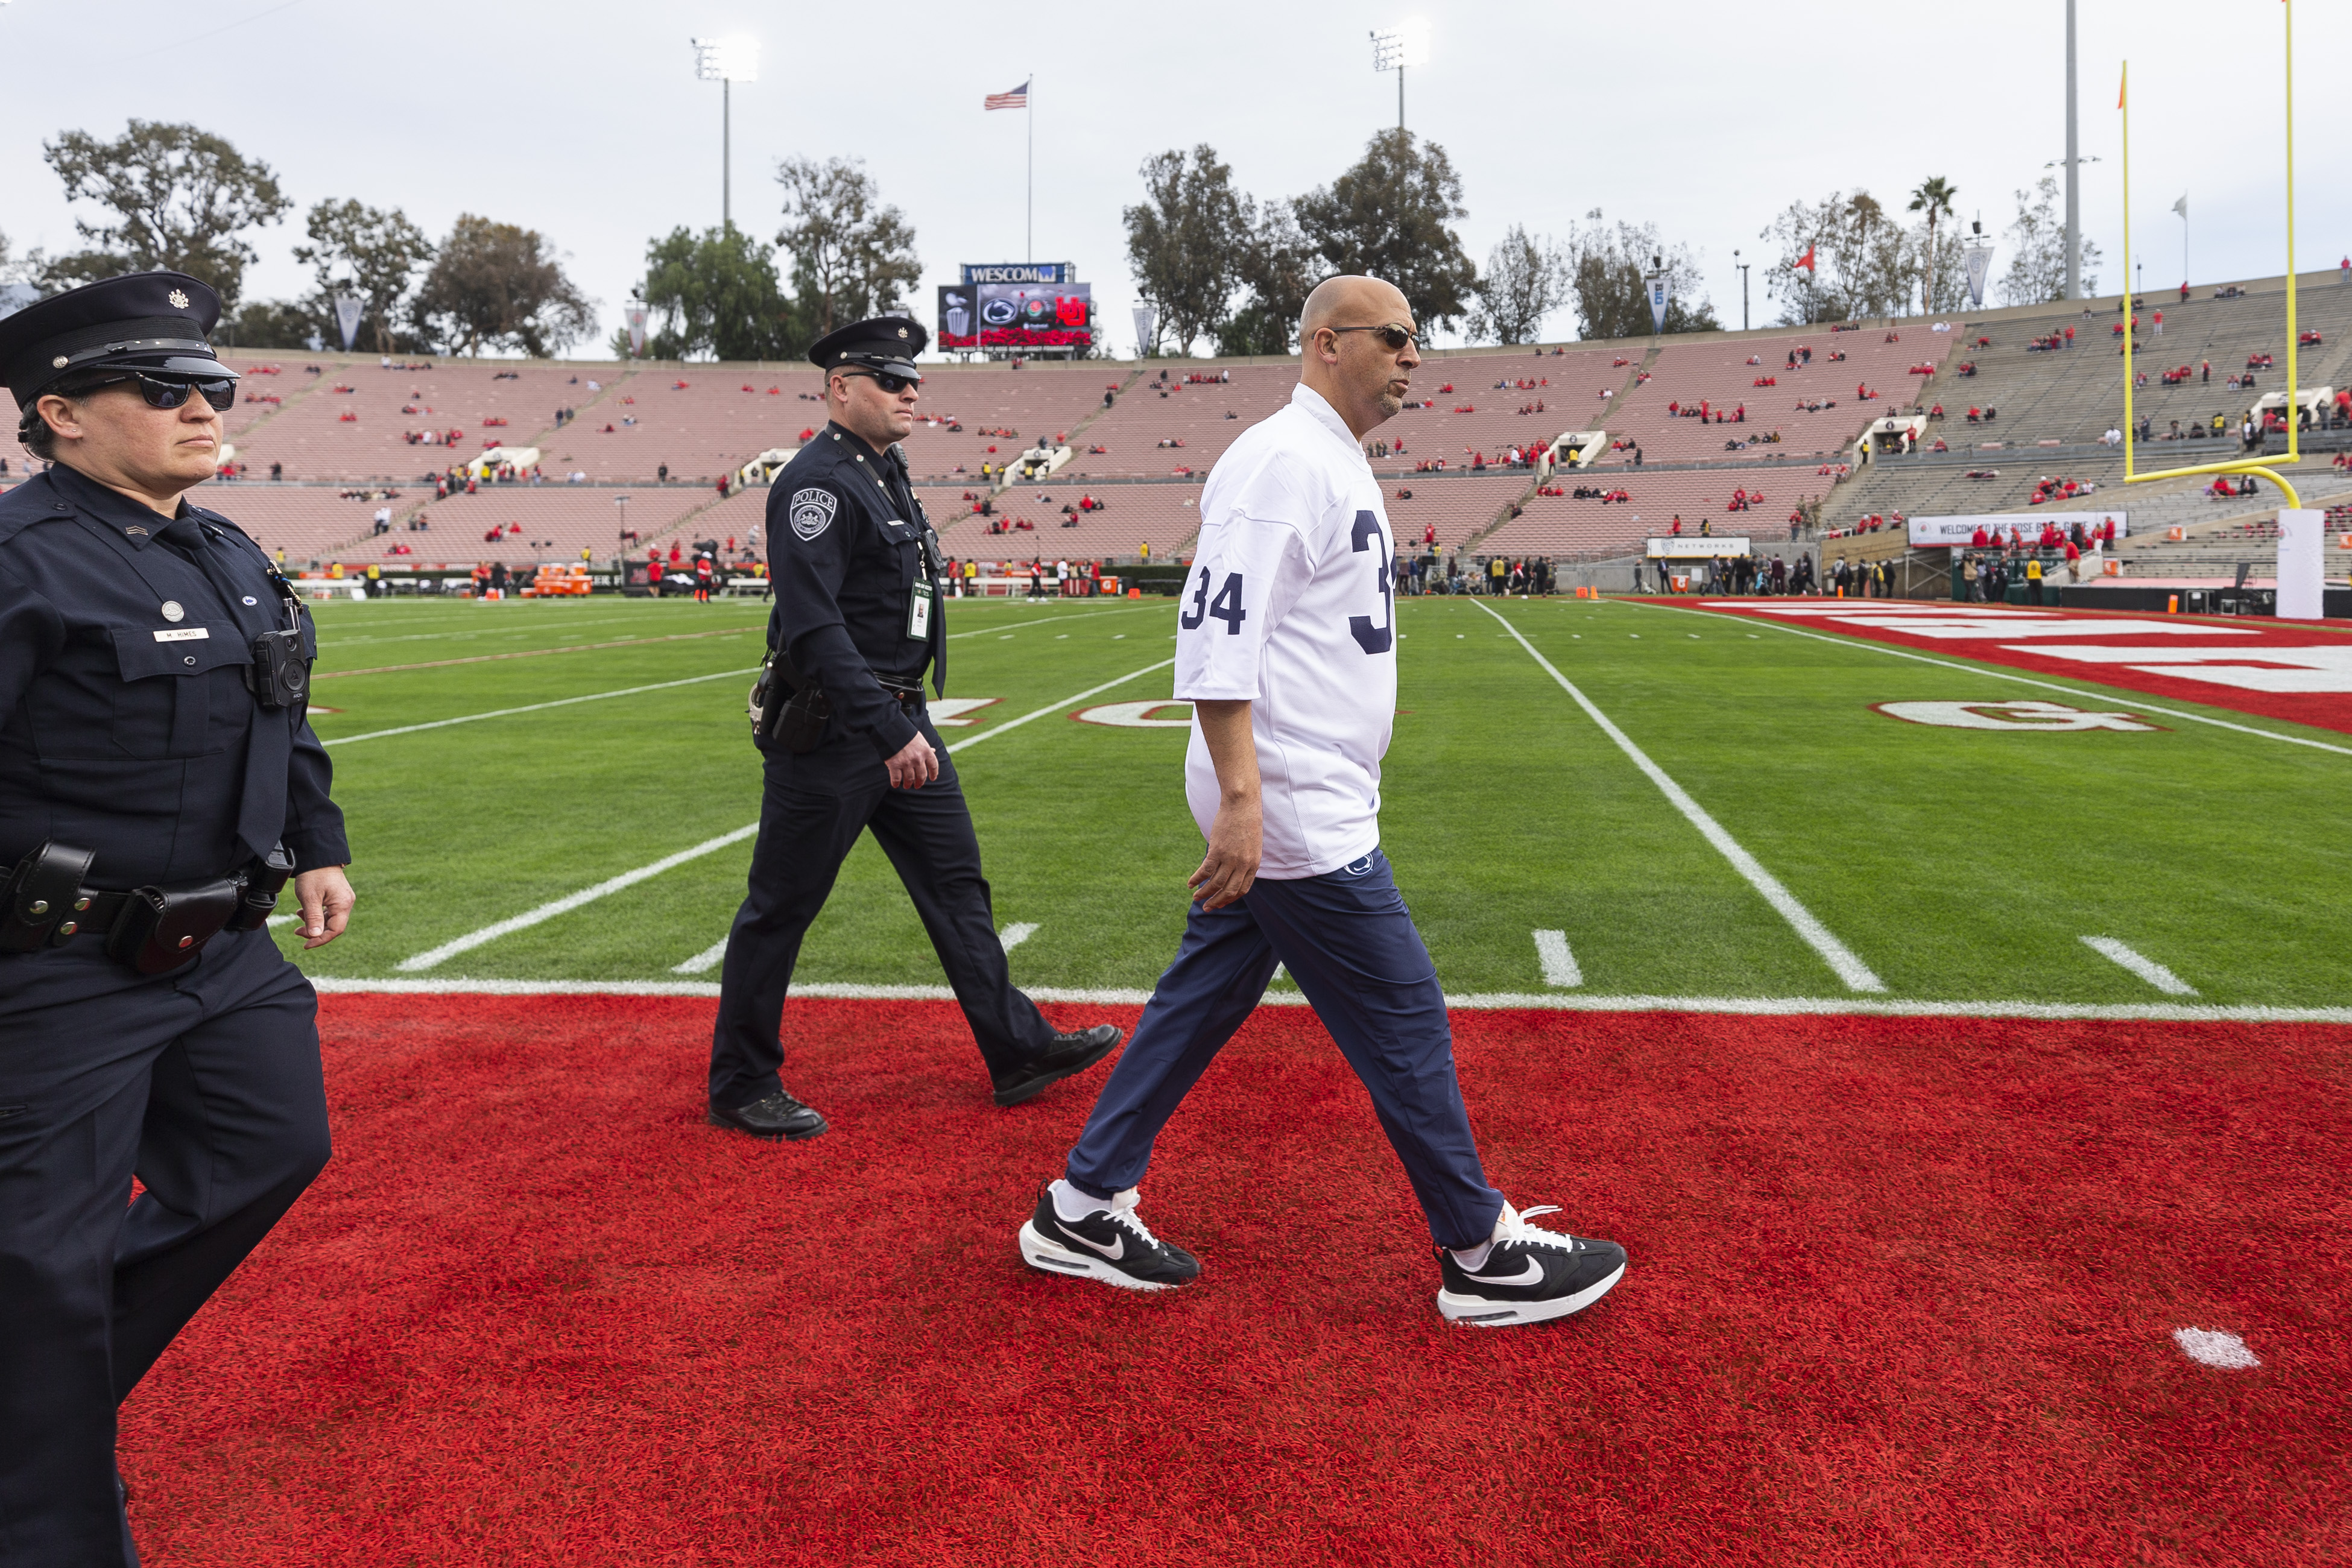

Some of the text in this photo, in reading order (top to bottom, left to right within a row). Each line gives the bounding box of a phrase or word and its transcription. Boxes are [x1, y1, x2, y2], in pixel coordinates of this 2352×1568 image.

[971, 267, 1037, 283] WESCOM
[794, 491, 833, 509] POLICE
[1181, 565, 1247, 635] 34
[1348, 510, 1396, 654] 3
